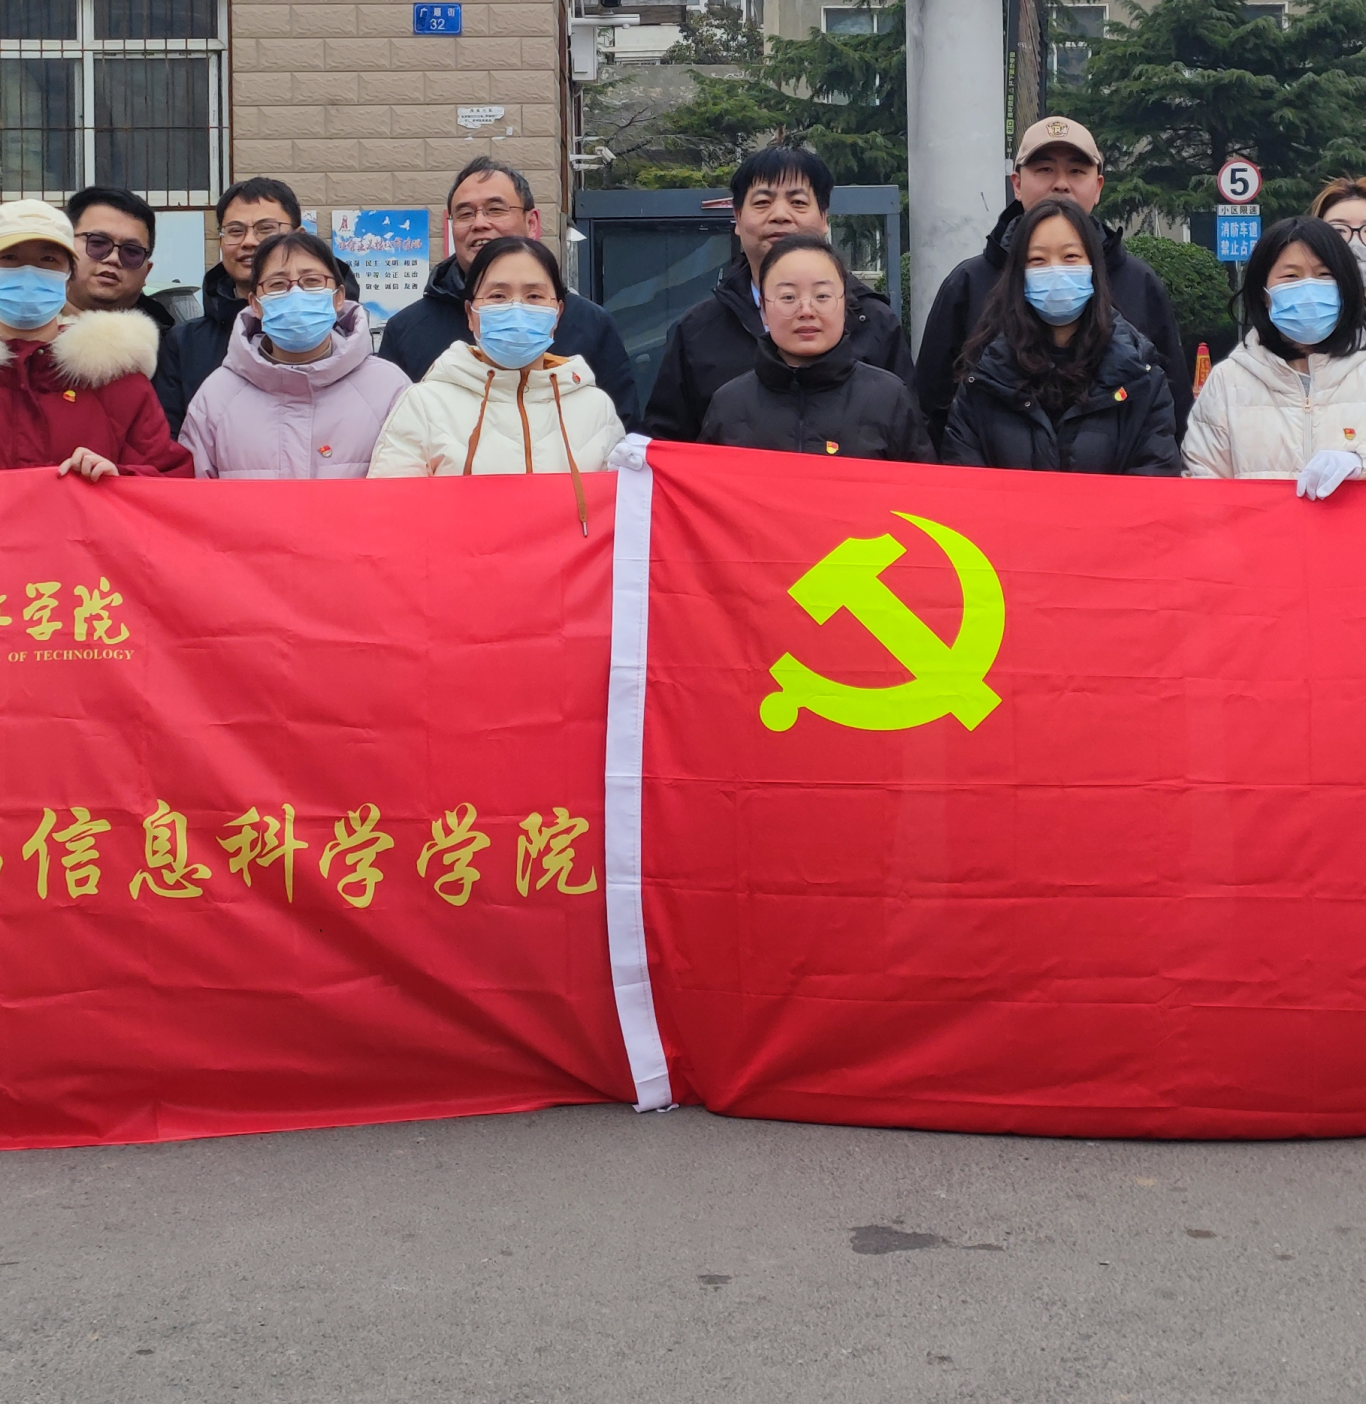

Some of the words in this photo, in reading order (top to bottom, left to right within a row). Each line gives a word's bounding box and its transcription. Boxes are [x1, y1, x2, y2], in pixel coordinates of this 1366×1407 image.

[429, 18, 446, 30] 32
[1230, 167, 1250, 196] 5
[1221, 205, 1258, 215] 小区限速
[1221, 221, 1258, 238] 消防车道
[8, 651, 28, 663] OF
[33, 649, 135, 662] TECHNOLOGY
